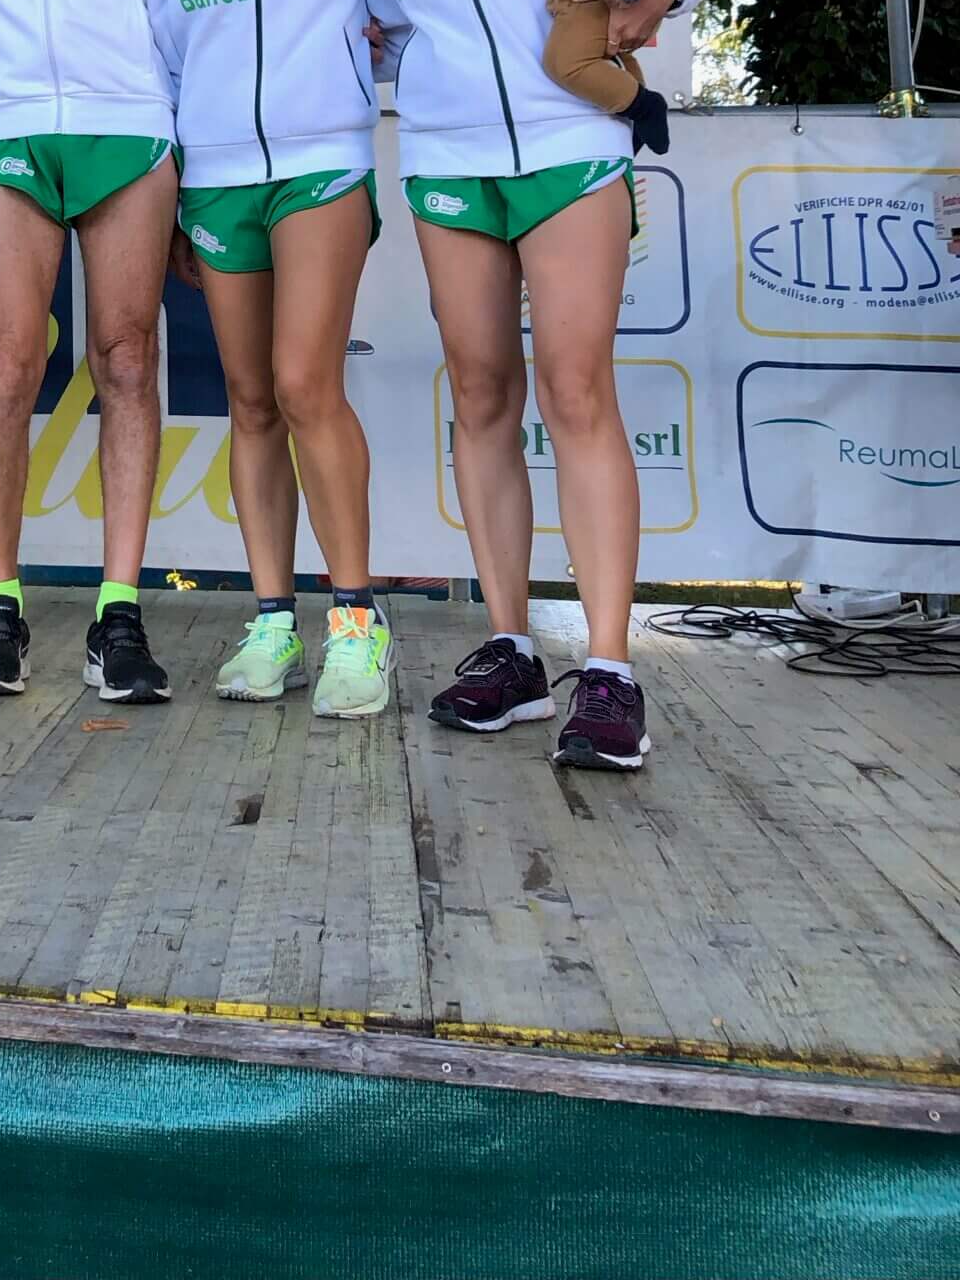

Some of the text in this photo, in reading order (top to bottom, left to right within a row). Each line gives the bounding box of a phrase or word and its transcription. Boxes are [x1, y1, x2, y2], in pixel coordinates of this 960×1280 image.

[794, 197, 925, 213] VERIFICHE DPR 462/01
[749, 213, 960, 292] ELLISS
[749, 270, 845, 308] www.ellisse.org
[866, 289, 960, 308] modena@elliss
[635, 423, 682, 456] srl
[840, 439, 960, 470] ReumaL
